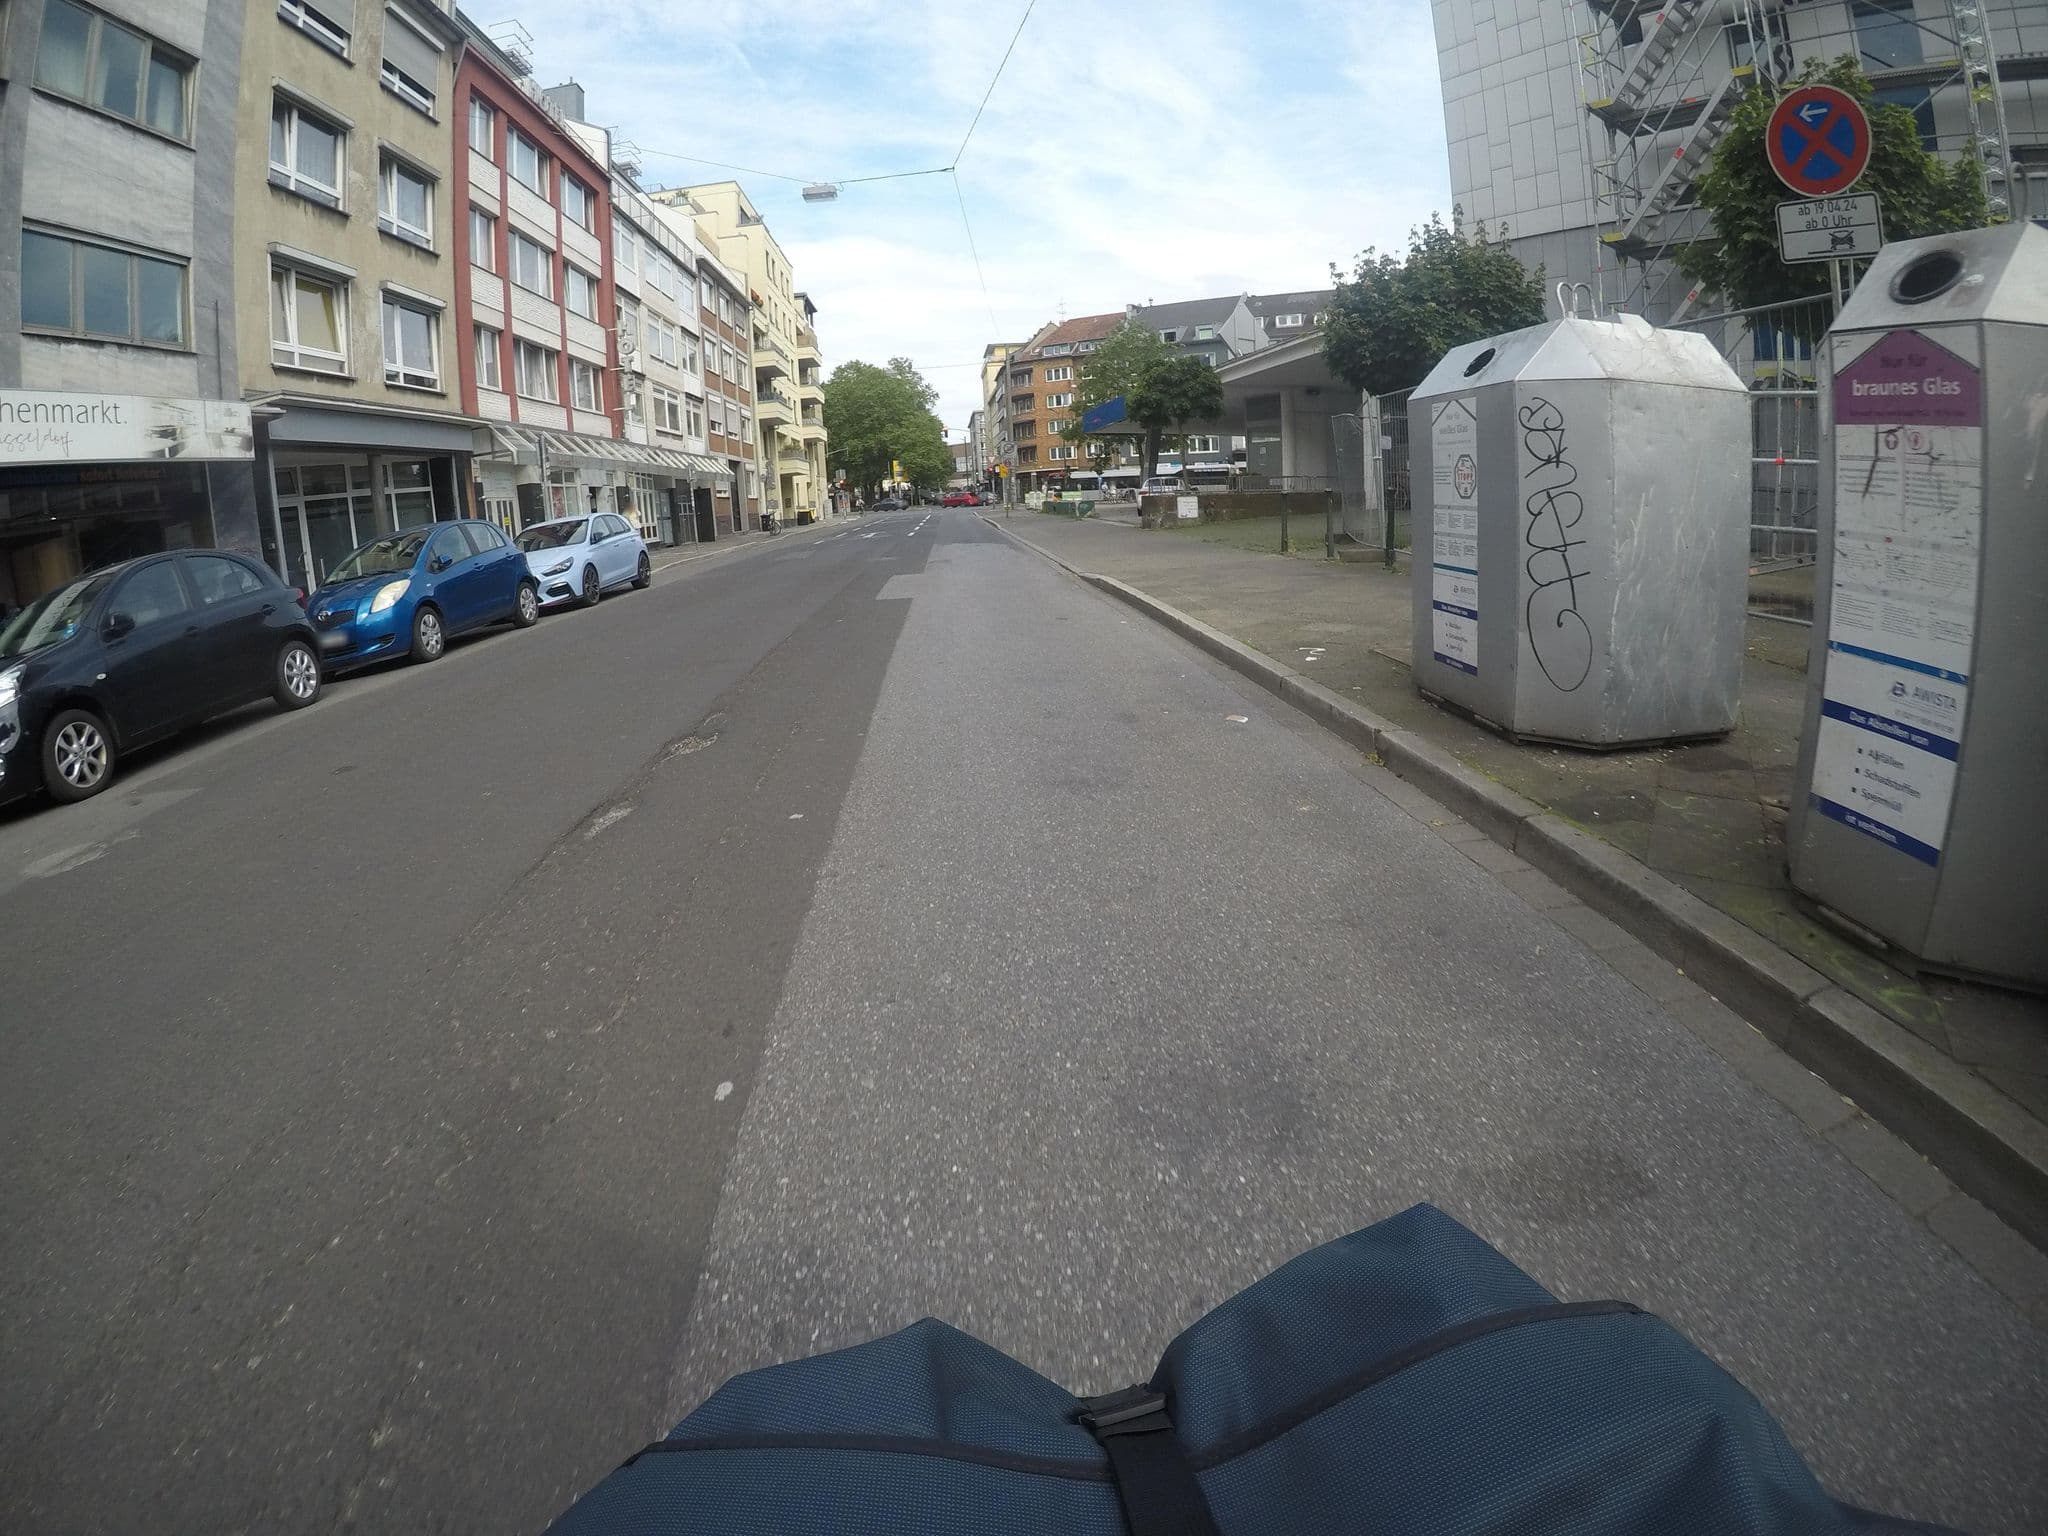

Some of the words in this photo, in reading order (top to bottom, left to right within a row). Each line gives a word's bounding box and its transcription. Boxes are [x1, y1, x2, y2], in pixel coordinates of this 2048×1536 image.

[1798, 203, 1811, 216] ab
[1805, 217, 1818, 229] ab
[1821, 215, 1829, 228] 0
[1832, 214, 1853, 228] Uhr
[1851, 379, 1919, 396] braunes
[1922, 377, 1961, 395] Glas
[1911, 686, 1958, 712] AWISTA
[1849, 710, 1867, 725] Das
[1866, 716, 1910, 740] Abstellen
[1910, 732, 1929, 746] von
[1863, 768, 1922, 799] Schadstoffen
